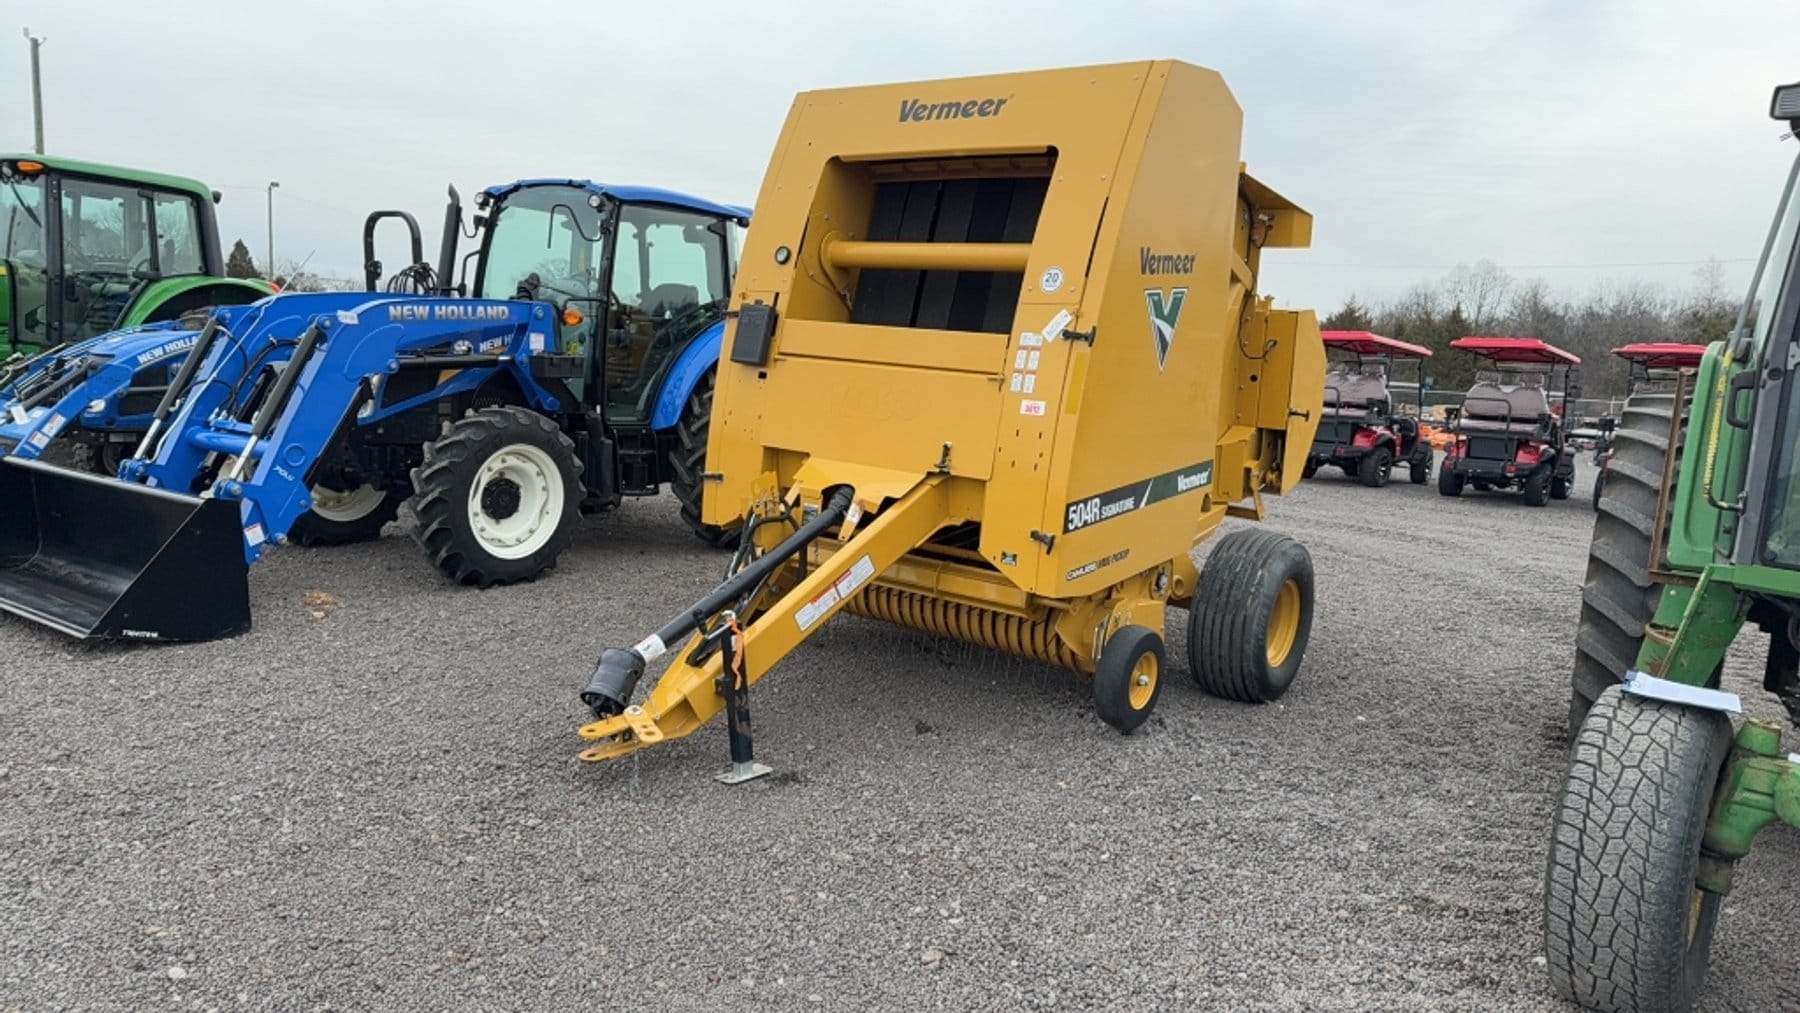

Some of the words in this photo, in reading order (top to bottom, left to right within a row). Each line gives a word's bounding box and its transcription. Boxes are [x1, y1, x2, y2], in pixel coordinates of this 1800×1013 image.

[899, 98, 1009, 123] Vermeer
[1140, 247, 1195, 275] Vermeer
[1044, 272, 1060, 283] 20
[388, 304, 430, 320] NEW
[434, 305, 509, 320] HOLLAND
[137, 346, 164, 364] NEW
[164, 335, 199, 353] HOLLA
[479, 337, 503, 354] NEW
[1067, 498, 1100, 531] 504R
[1101, 497, 1135, 518] SIGNATURE
[1177, 471, 1209, 492] Vermeer
